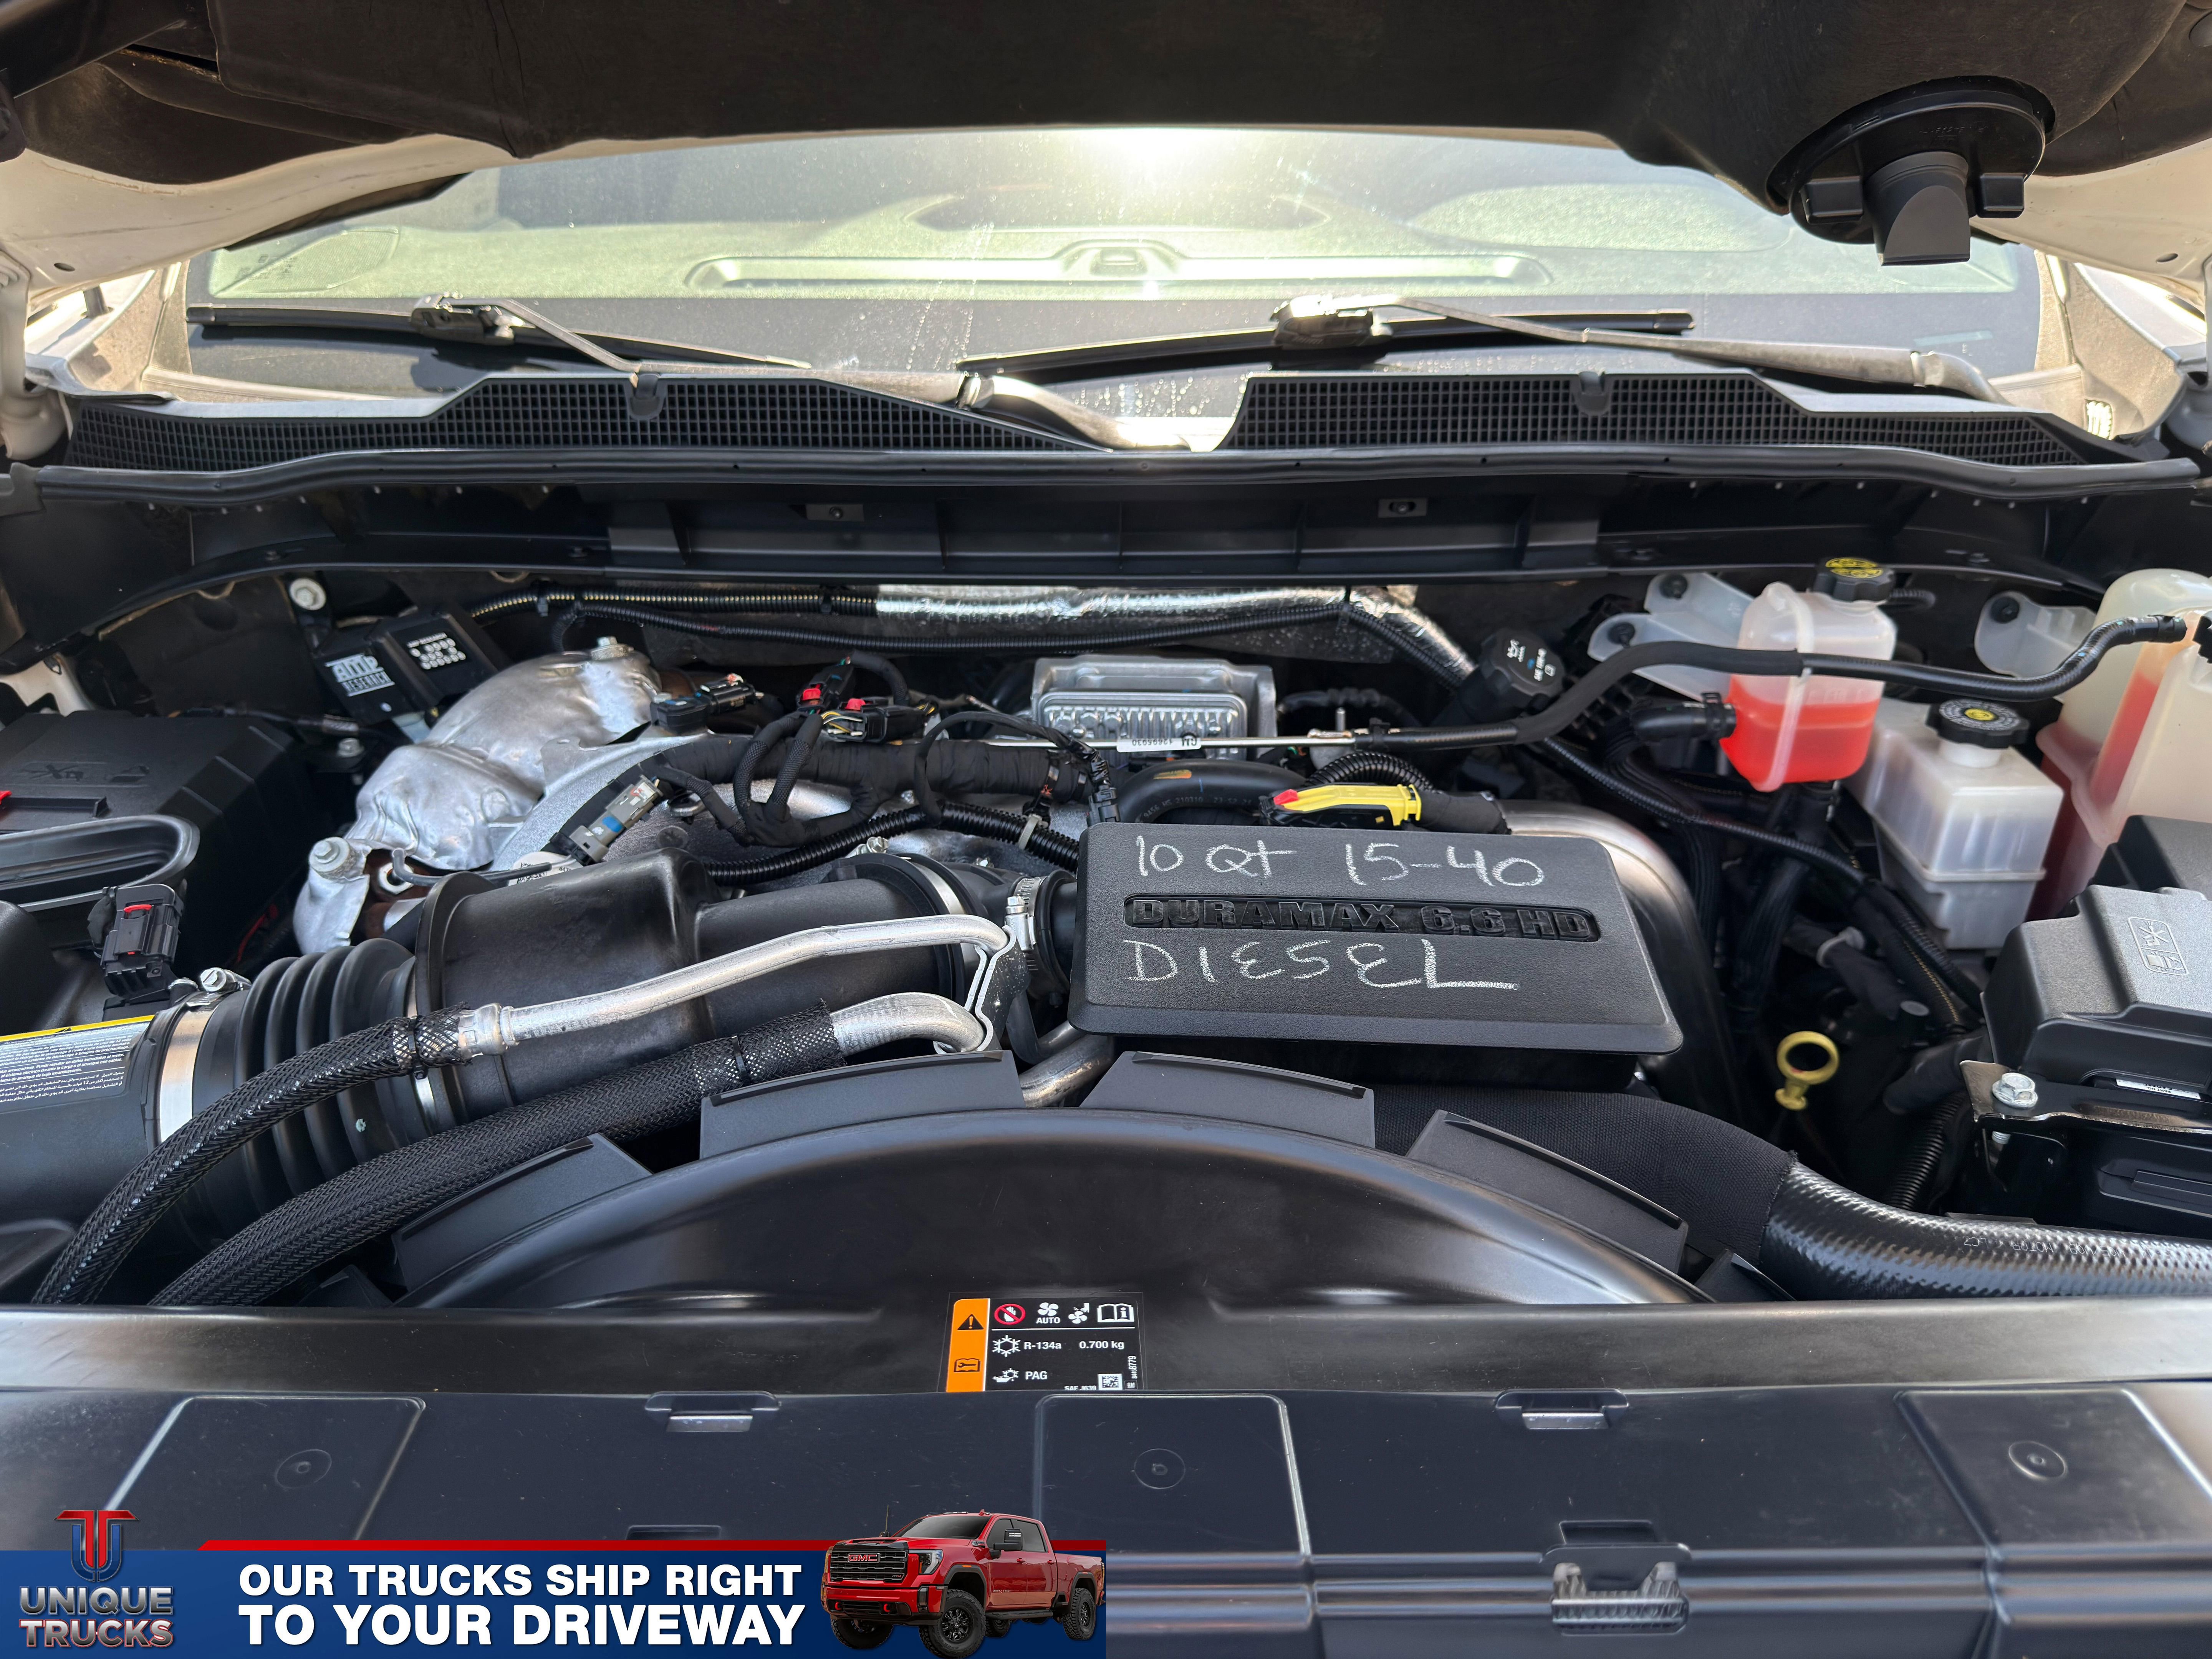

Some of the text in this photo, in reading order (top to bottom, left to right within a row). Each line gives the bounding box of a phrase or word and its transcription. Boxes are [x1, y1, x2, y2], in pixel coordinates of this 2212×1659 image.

[1136, 834, 1184, 876] 10
[1344, 842, 1545, 887] 15-40
[1132, 898, 1599, 941] DURAMAX 6.6 HD
[1123, 939, 1521, 990] DIESEL
[1036, 1316, 1060, 1325] AUTO
[1024, 1340, 1124, 1350] R-134a 0.700 kg
[1025, 1371, 1048, 1380] PAG
[1128, 1355, 1137, 1379] 84468779
